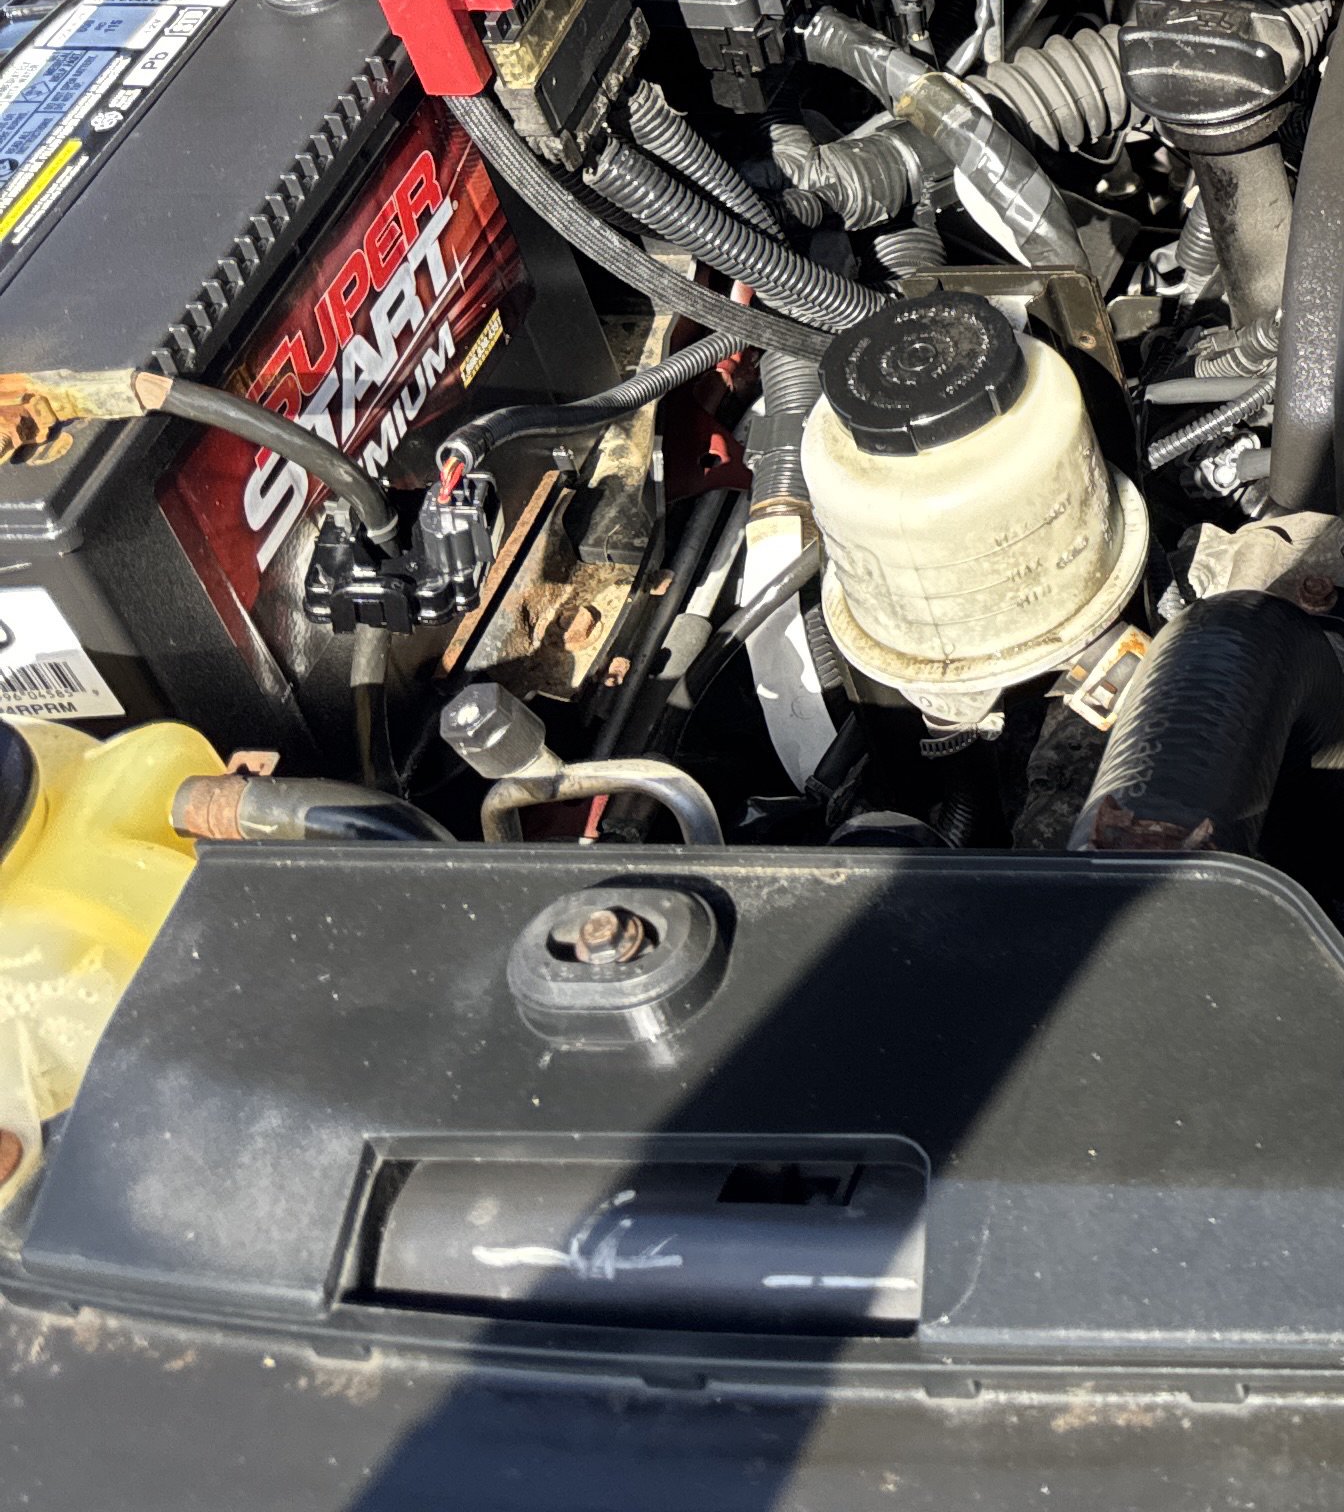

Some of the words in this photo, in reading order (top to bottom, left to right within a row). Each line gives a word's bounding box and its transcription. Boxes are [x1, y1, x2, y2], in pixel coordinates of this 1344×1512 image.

[105, 20, 123, 32] 115
[141, 52, 168, 69] Pb
[244, 195, 453, 572] START
[246, 150, 442, 470] SUPER
[357, 320, 455, 477] MIUM
